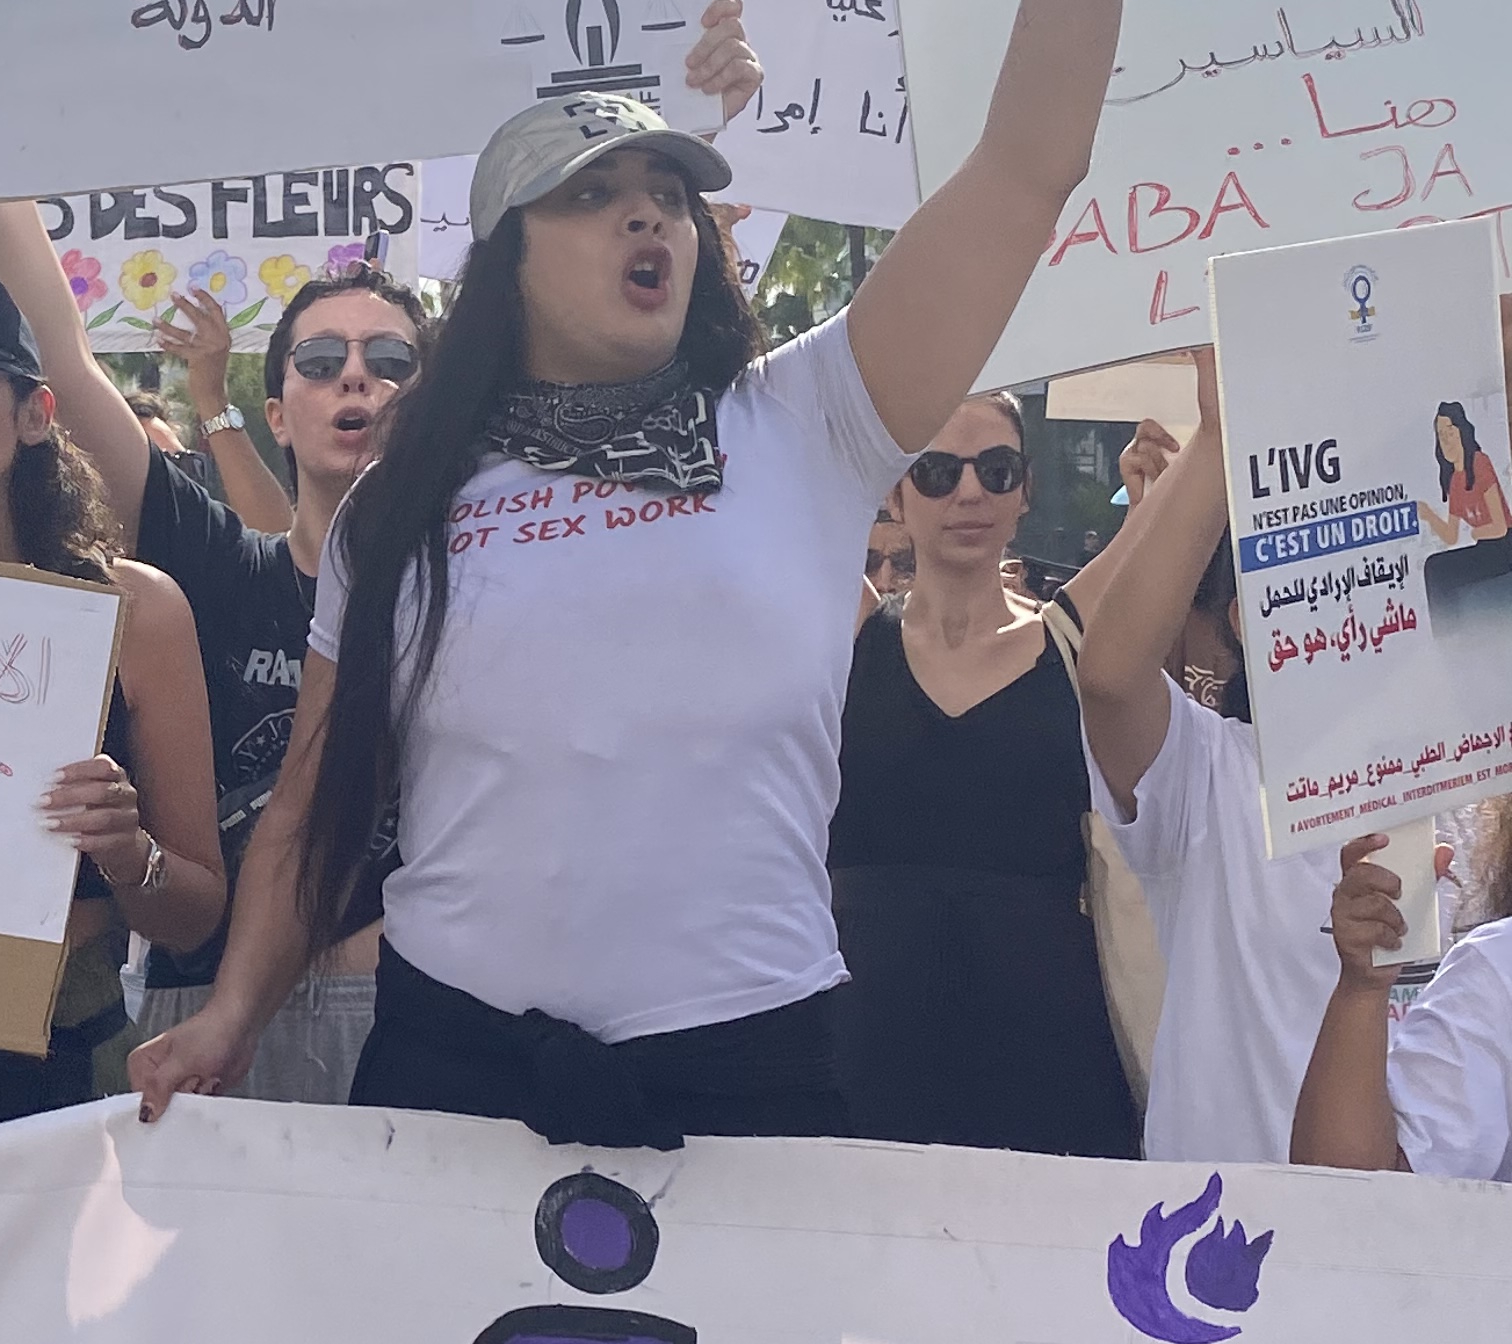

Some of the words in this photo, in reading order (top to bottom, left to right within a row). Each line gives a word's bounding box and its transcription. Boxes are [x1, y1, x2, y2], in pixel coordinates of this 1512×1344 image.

[1300, 72, 1457, 139] هنا
[89, 185, 197, 241] DES
[209, 162, 415, 240] FLEURS
[1045, 170, 1271, 268] ABA
[1351, 142, 1475, 212] JA
[1248, 438, 1342, 499] L'IVG
[449, 526, 500, 555] OT
[512, 514, 587, 544] SEX
[604, 493, 717, 530] WORK
[450, 486, 554, 524] OLISH
[1252, 507, 1289, 531] N'EST
[1292, 500, 1318, 523] PAS
[1318, 495, 1347, 517] UNE
[1348, 483, 1409, 510] OPINION,
[1254, 527, 1311, 563] C'EST
[1316, 519, 1346, 549] UN
[1350, 506, 1420, 541] DROIT.
[1259, 577, 1305, 619] للحمل
[1369, 597, 1418, 654] ماشي
[1267, 627, 1300, 673] حق
[1303, 626, 1328, 665] هو
